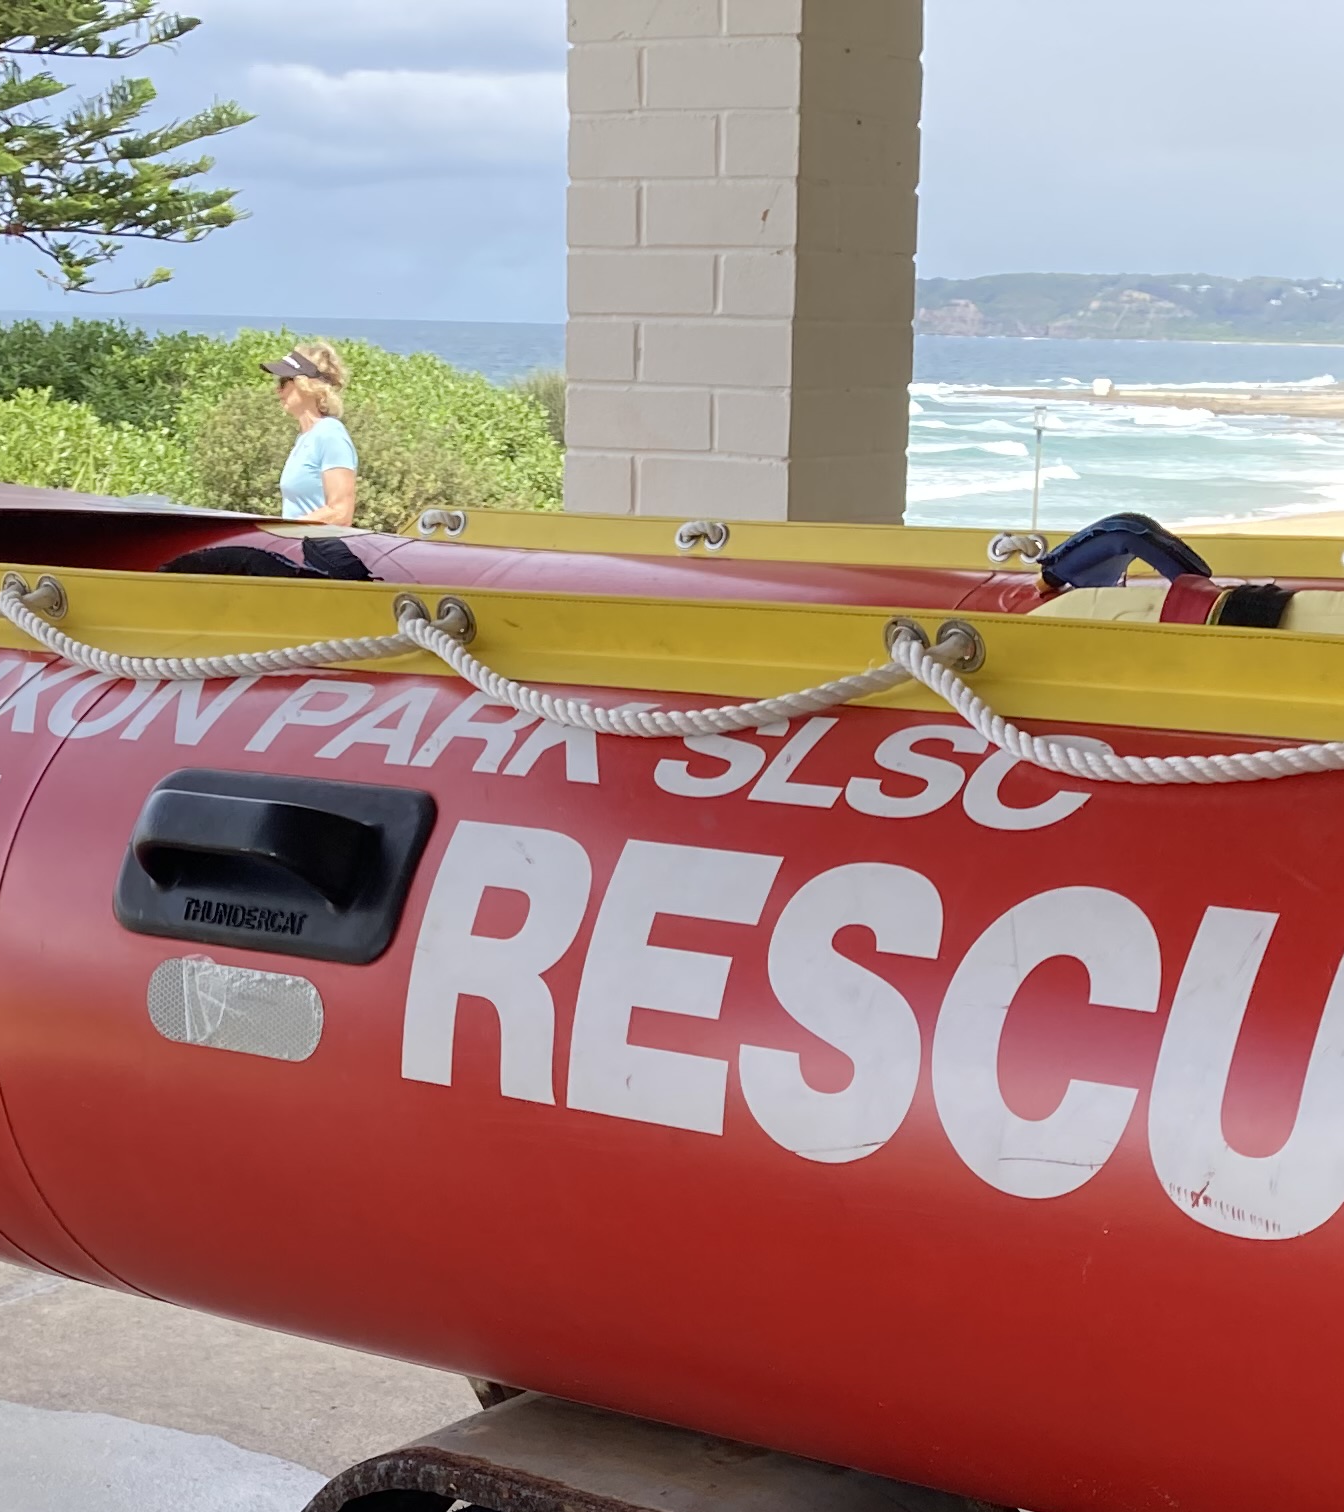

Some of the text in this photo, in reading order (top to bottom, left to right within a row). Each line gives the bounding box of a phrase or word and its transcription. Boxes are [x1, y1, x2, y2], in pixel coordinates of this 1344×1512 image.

[244, 678, 658, 785] PARK
[653, 714, 1113, 831] SLSC
[183, 896, 310, 936] THUNDERCAT
